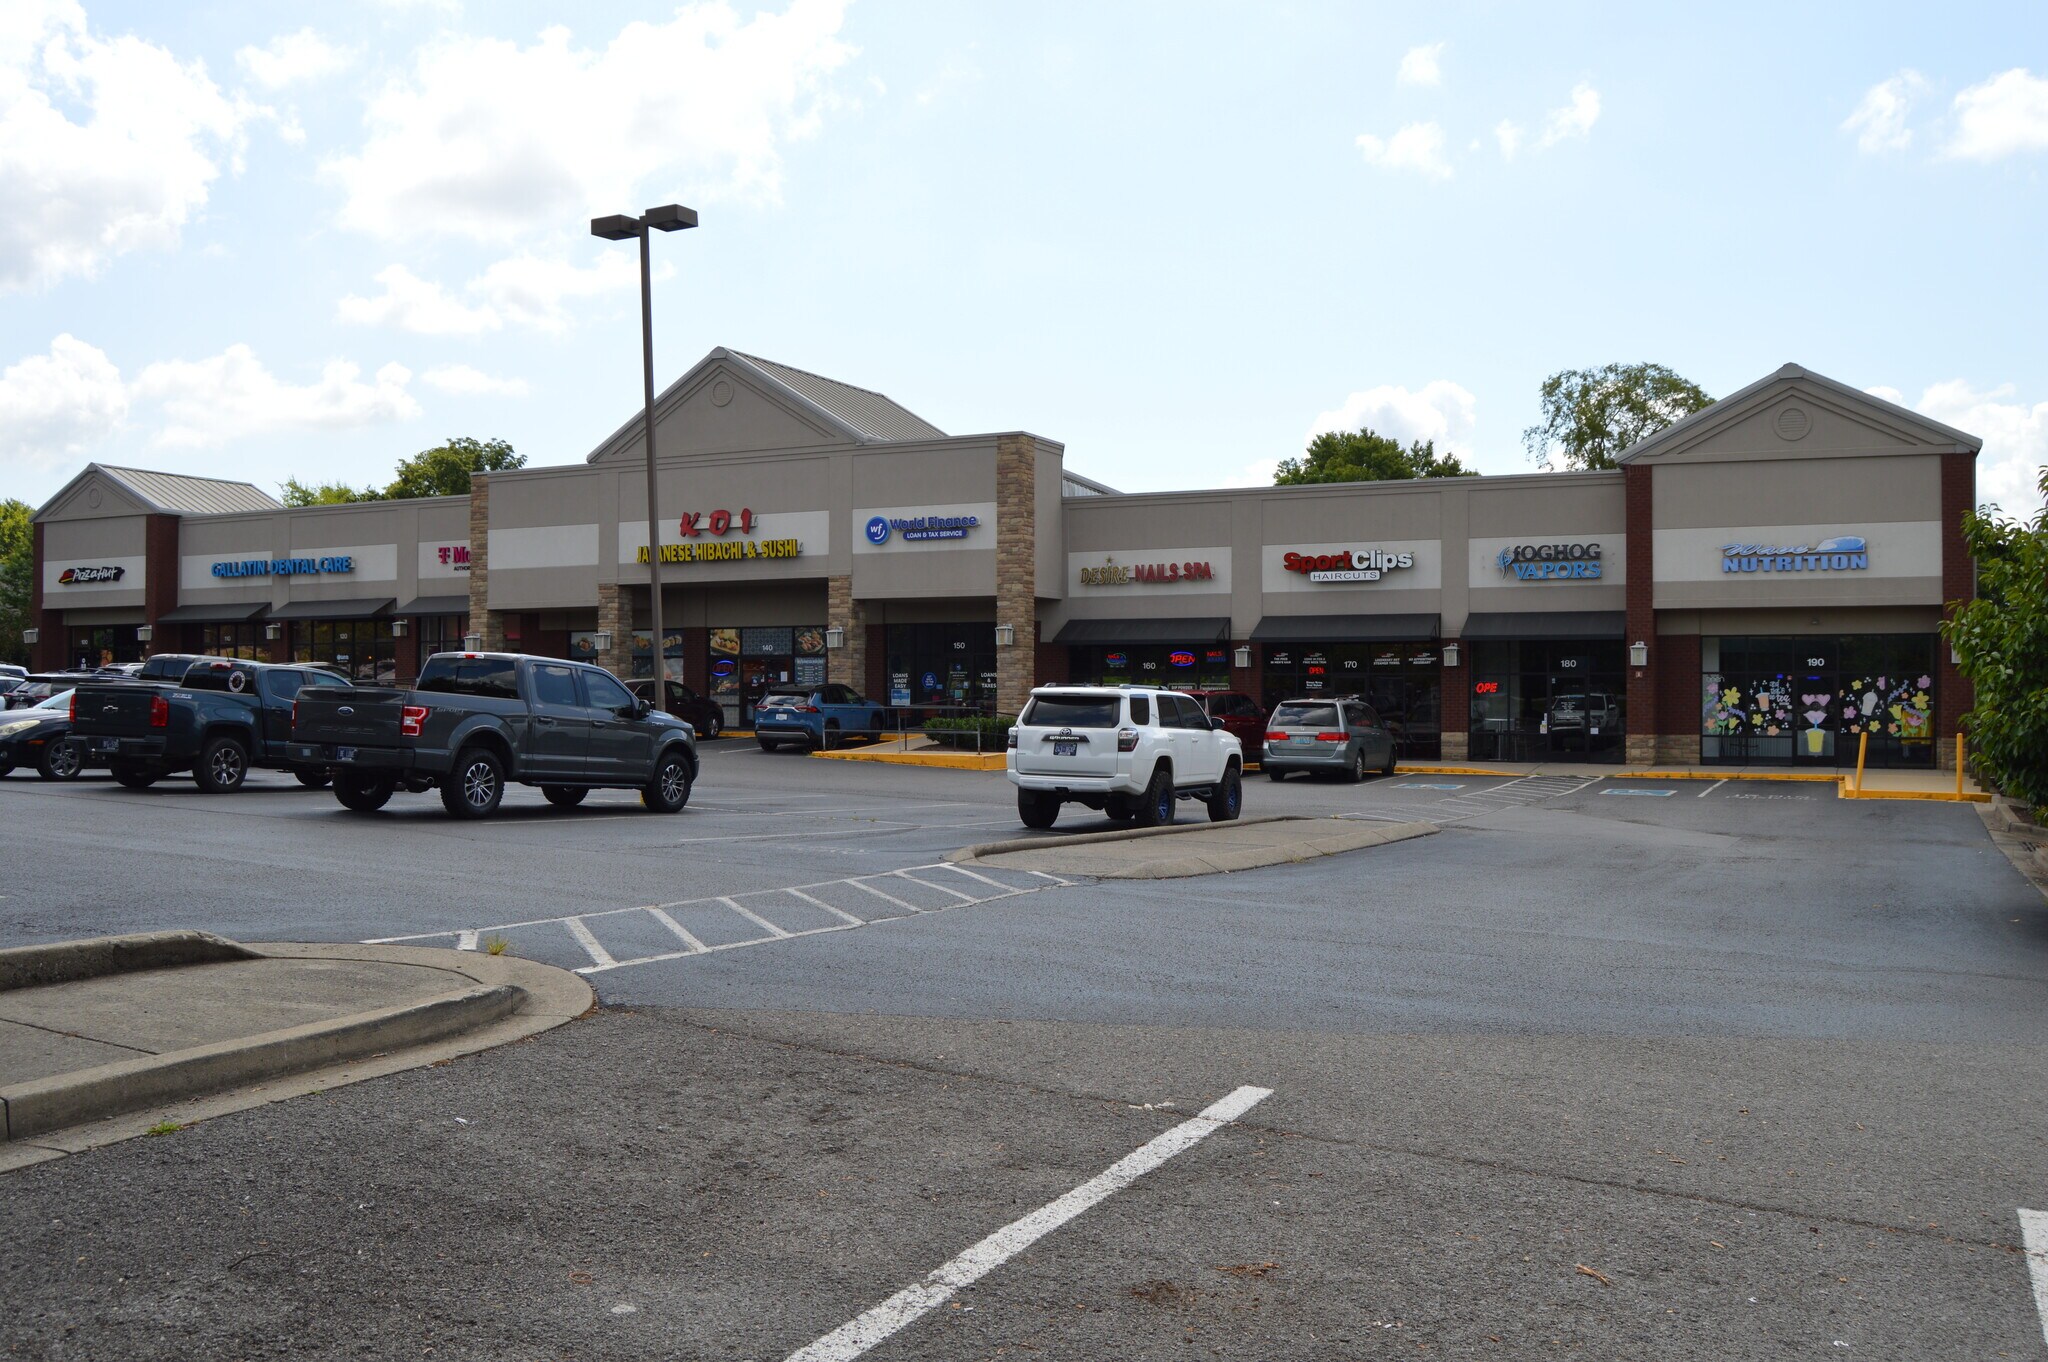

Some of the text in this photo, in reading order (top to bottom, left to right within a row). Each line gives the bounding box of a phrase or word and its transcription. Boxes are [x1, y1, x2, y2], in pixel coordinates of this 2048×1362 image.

[890, 516, 977, 530] World Finance
[637, 538, 799, 563] JAANESE HIBACHI & SUSHI
[1721, 542, 1809, 557] Wave
[211, 556, 352, 577] GALLATIN DENTAL CARE
[1512, 561, 1601, 579] VAPORS
[1722, 554, 1868, 573] NUTRITION
[1081, 562, 1213, 585] DESIRE NAILS SPA
[1313, 571, 1377, 580] HAIRCUTS
[1143, 662, 1156, 670] 160
[1344, 660, 1358, 669] 170
[1561, 660, 1577, 668] 180
[1807, 658, 1825, 667] 190
[1309, 667, 1324, 675] OPEN
